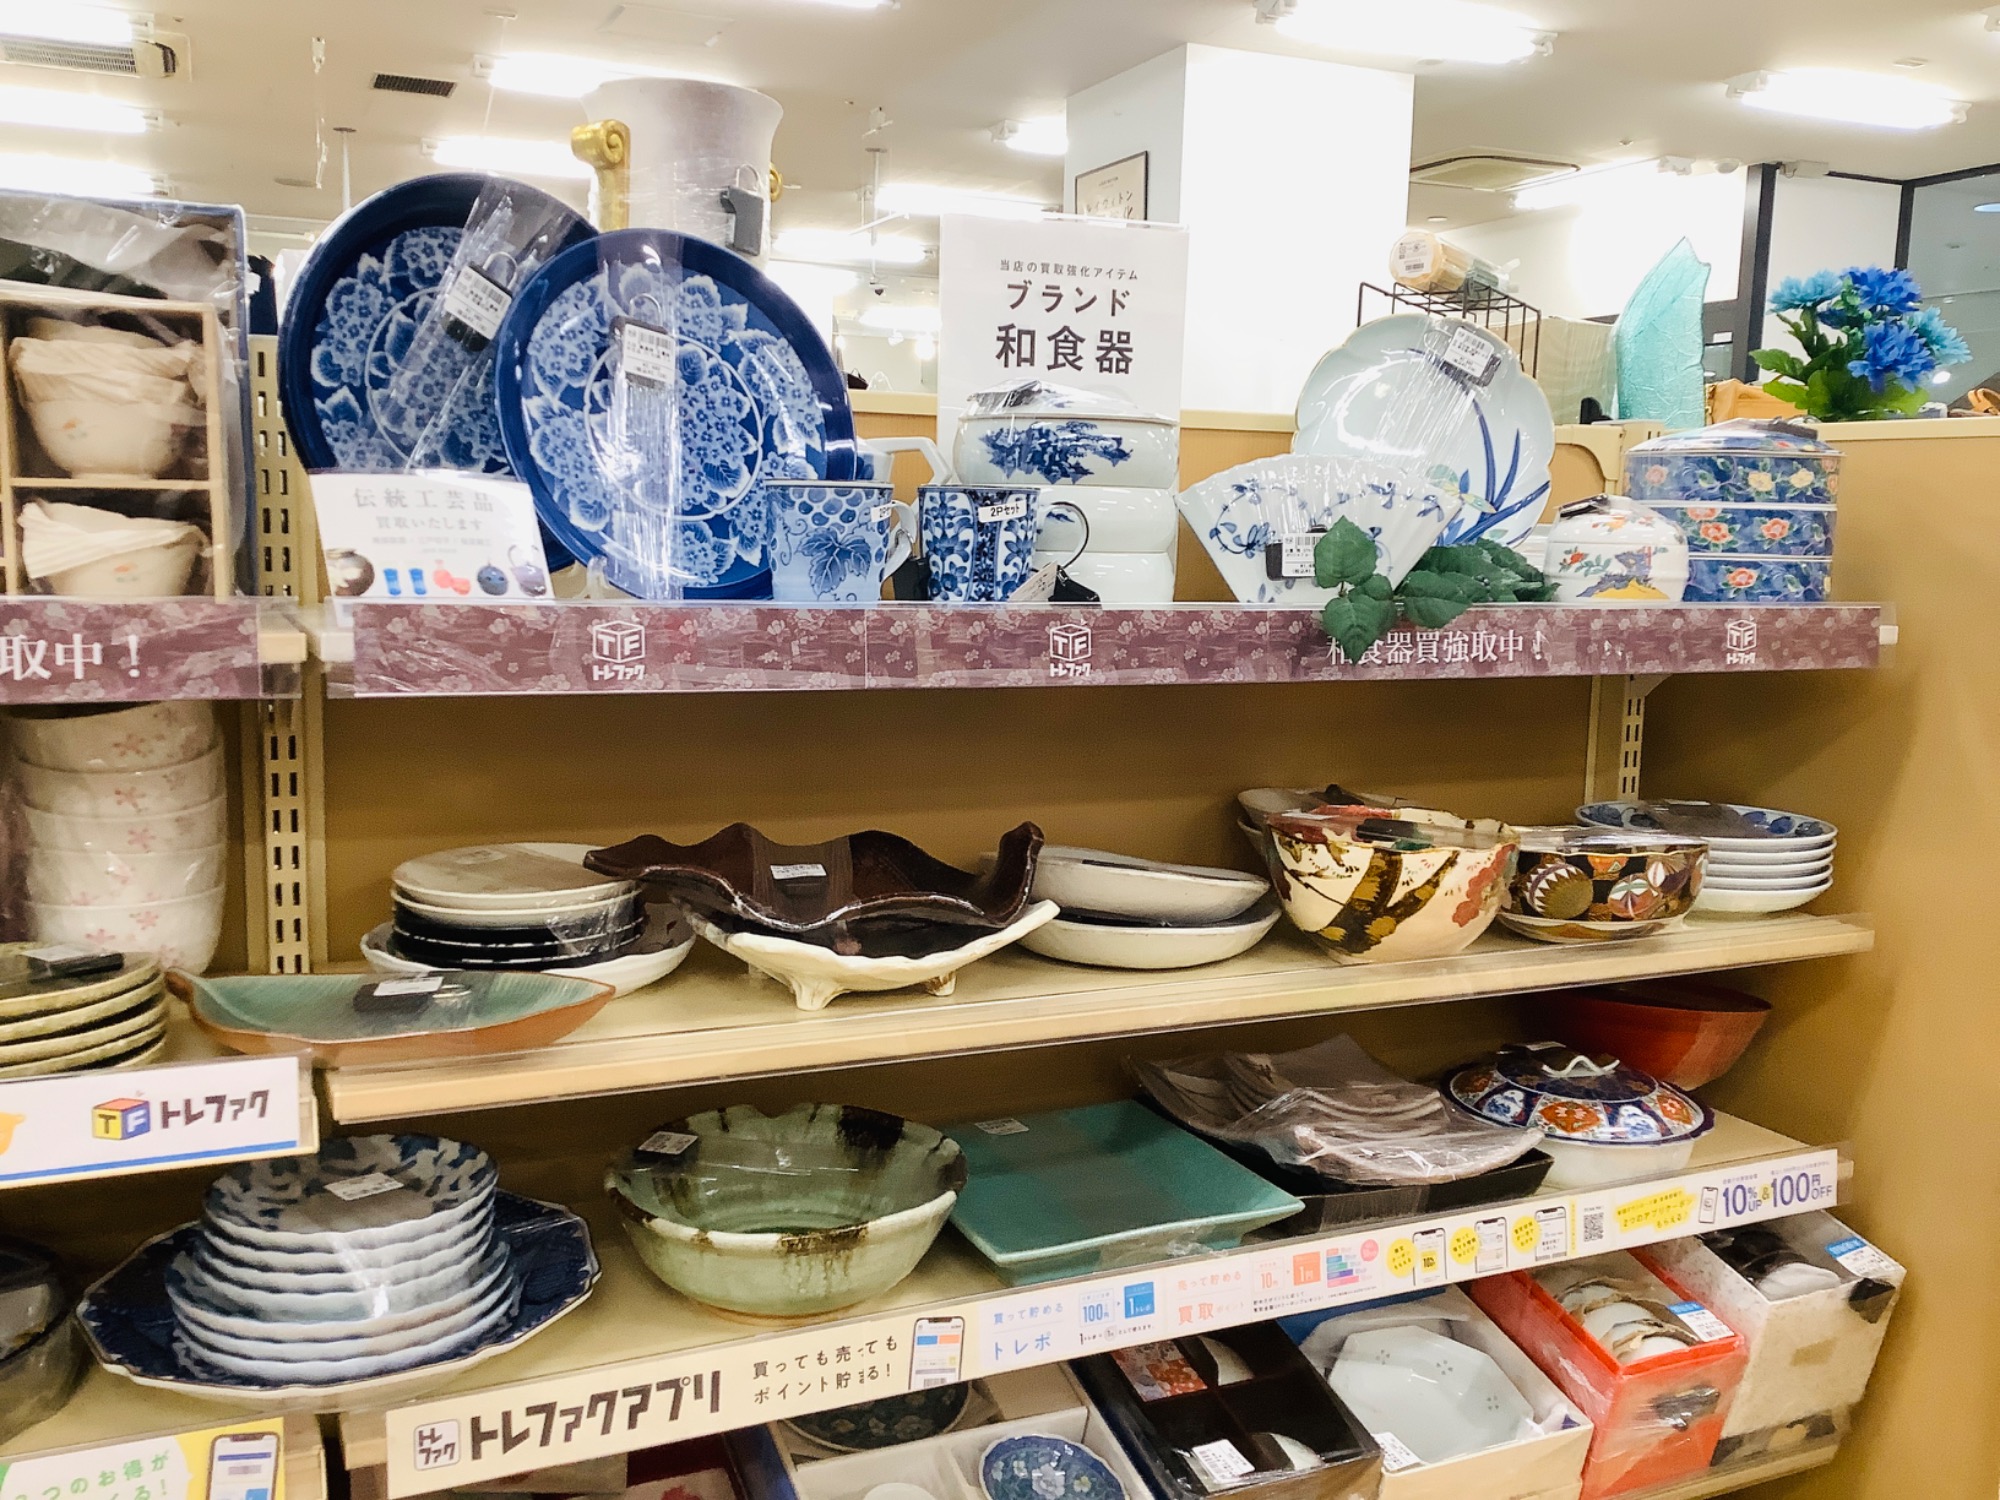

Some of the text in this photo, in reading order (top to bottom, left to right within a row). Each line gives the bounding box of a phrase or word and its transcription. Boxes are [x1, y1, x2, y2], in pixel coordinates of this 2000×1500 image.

[1000, 259, 1138, 280] 当店の買取強化アイテム
[1006, 279, 1131, 317] ブランド
[995, 323, 1134, 375] 和食器
[354, 487, 494, 512] 伝統工芸品
[376, 515, 483, 531] 買取いたします
[592, 664, 646, 681] トレファク
[1049, 662, 1092, 677] トレファク
[160, 1089, 270, 1130] トレファク
[1811, 1184, 1833, 1200] OFF
[993, 1302, 1064, 1325] 買って貯める
[752, 1335, 898, 1380] 買っても売っても
[994, 1331, 1051, 1361] トレポ
[470, 1370, 721, 1461] トレファクアプリ
